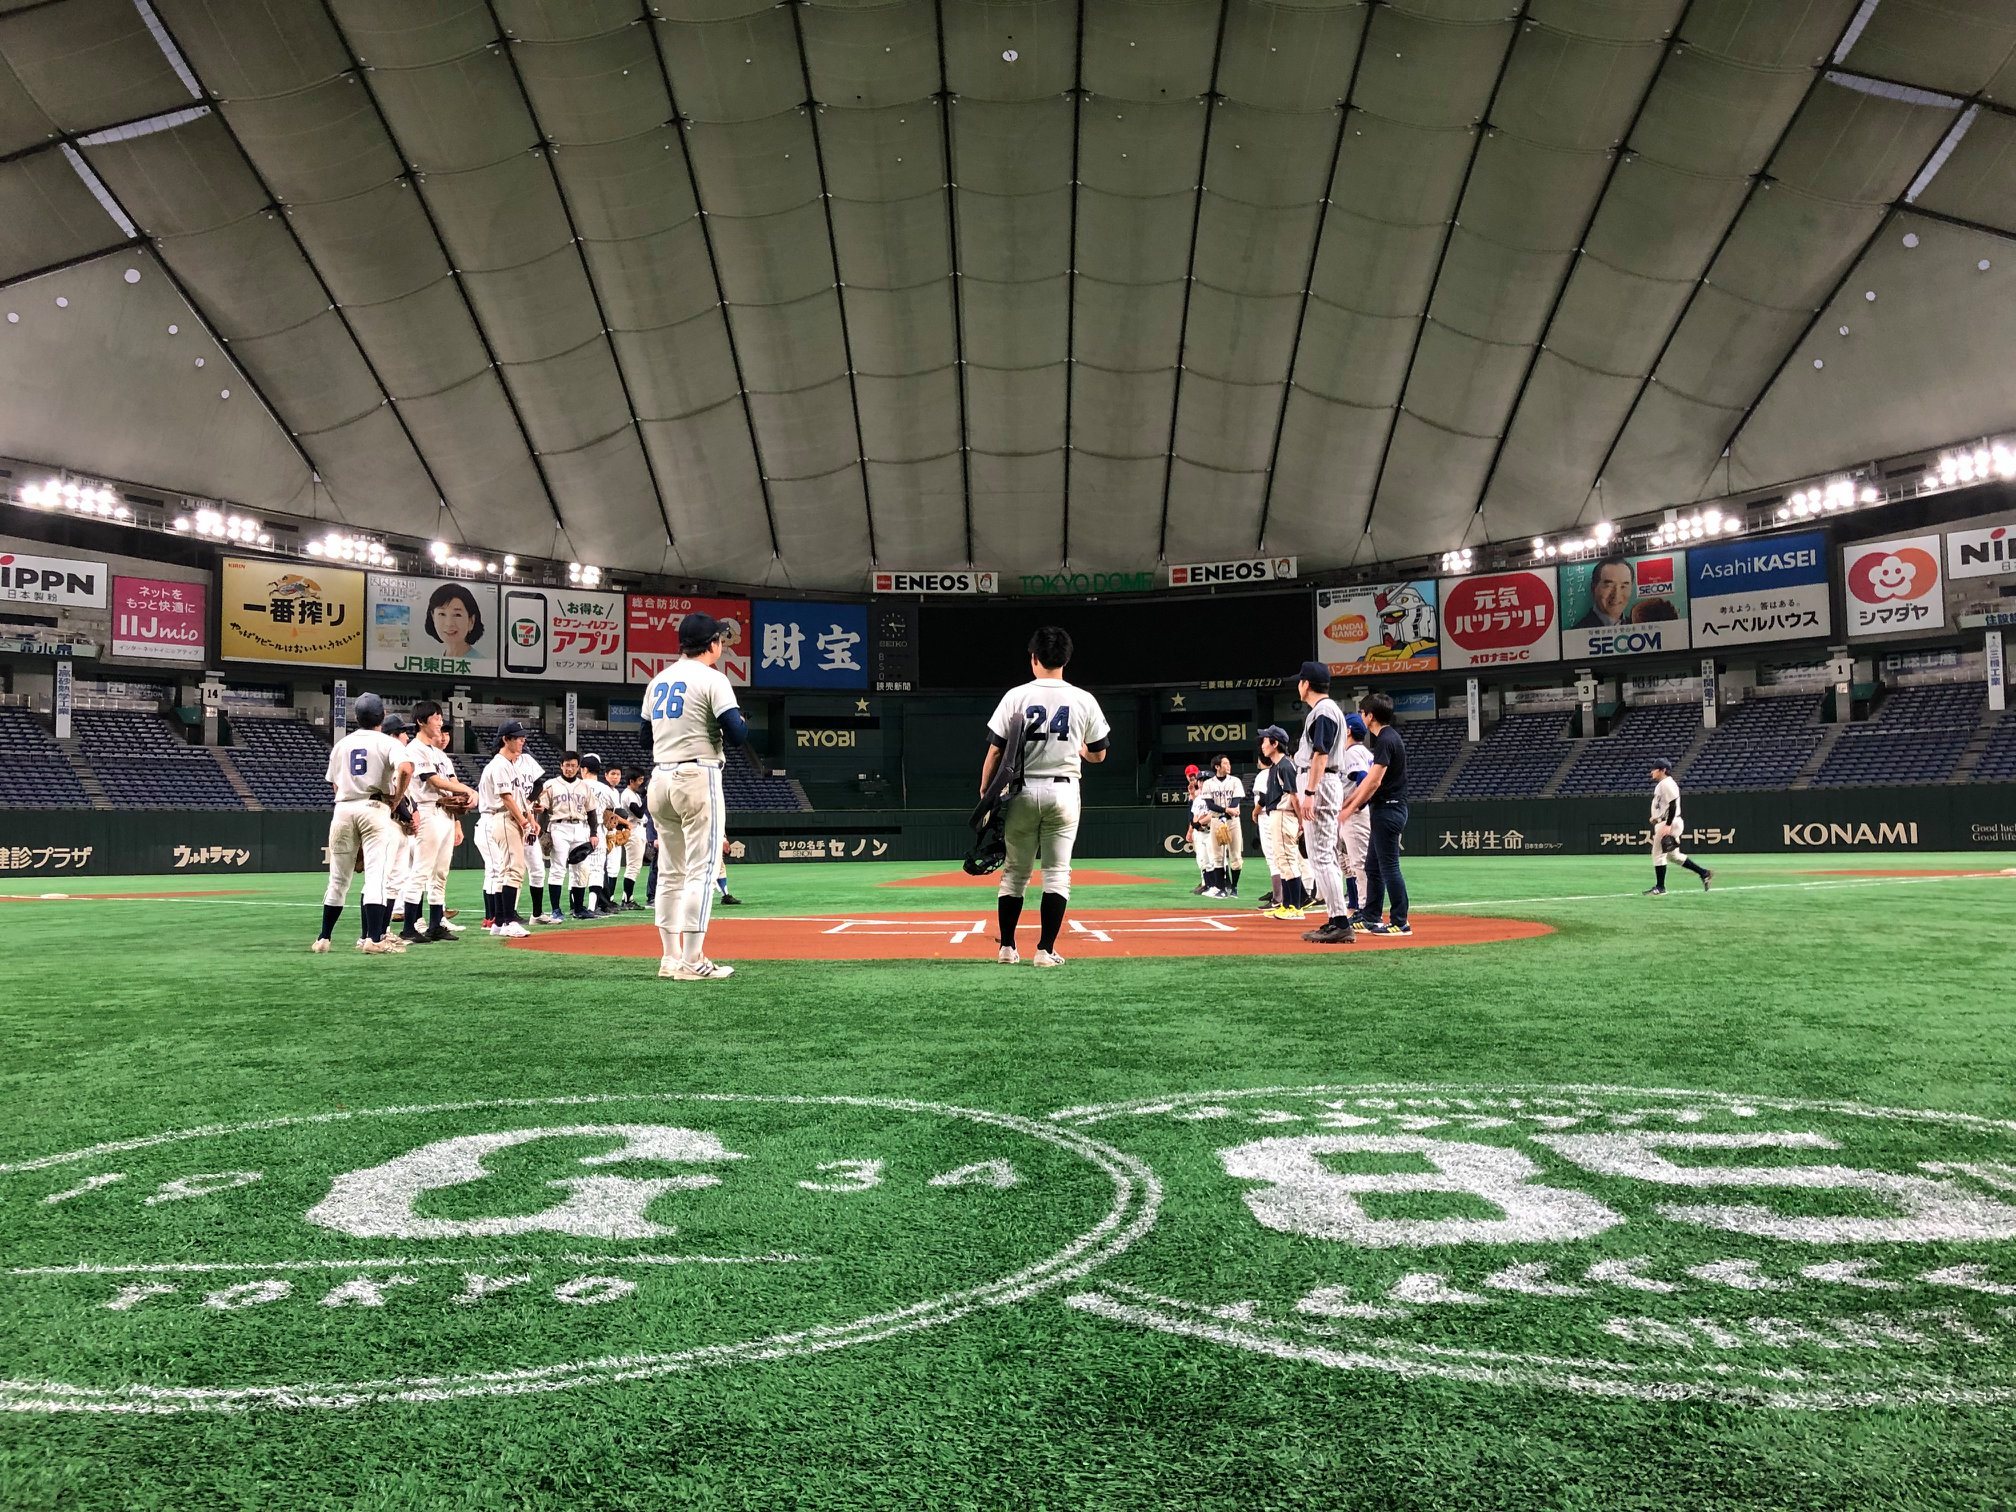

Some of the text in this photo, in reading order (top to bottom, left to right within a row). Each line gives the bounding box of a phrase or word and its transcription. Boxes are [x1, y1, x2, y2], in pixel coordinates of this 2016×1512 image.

[1190, 561, 1267, 583] ENEOS
[1700, 549, 1816, 580] AsahiKASEI
[894, 574, 970, 591] ENEOS
[1019, 571, 1156, 594] TOKYO DOME
[1638, 583, 1673, 595] SECOM
[8, 589, 58, 603] 日本製粉
[139, 586, 183, 599] ネットを
[1473, 586, 1520, 611] 元気
[126, 598, 196, 614] もっと快適に
[567, 602, 604, 616] お得な
[631, 597, 692, 610] 総合防災の
[243, 598, 345, 627] 一番搾り
[1453, 604, 1546, 635] ハツラツ!
[1859, 602, 1929, 627] シマダヤ
[120, 614, 199, 641] IIJmio
[552, 617, 618, 630] セブン-イレブン
[1331, 622, 1364, 631] BANDAI
[1702, 611, 1819, 636] ヘーベルハウス
[552, 630, 621, 655] アプリ
[1331, 630, 1364, 638] NAMCO
[761, 622, 861, 671] 財宝
[879, 640, 908, 648] SEIKO
[1588, 632, 1662, 655] SECOM
[393, 655, 472, 675] JR東日本
[878, 653, 885, 661] B
[1392, 659, 1431, 669] グループ
[1469, 650, 1530, 665] オロナミンC
[878, 663, 885, 671] S
[1837, 665, 1844, 675] 1
[207, 688, 219, 699] 14
[876, 682, 911, 691] 読売新聞
[1583, 685, 1590, 695] 3
[457, 701, 464, 711] 4
[652, 681, 687, 720] 26
[1025, 705, 1071, 742] 24
[796, 730, 856, 747] RYOBI
[1186, 723, 1247, 742] RYOBI
[350, 748, 368, 776] 6
[554, 793, 586, 805] TOKYO
[1783, 822, 1919, 845] KONAMI
[1971, 823, 2016, 833] Good luc
[778, 840, 826, 850] 守りの名手
[1438, 829, 1524, 850] 大樹生命
[1972, 832, 1999, 842] Good
[173, 845, 251, 868] ウルトラマン
[829, 838, 888, 858] セノン
[305, 1123, 751, 1240] G
[1219, 1130, 2016, 1249] 85
